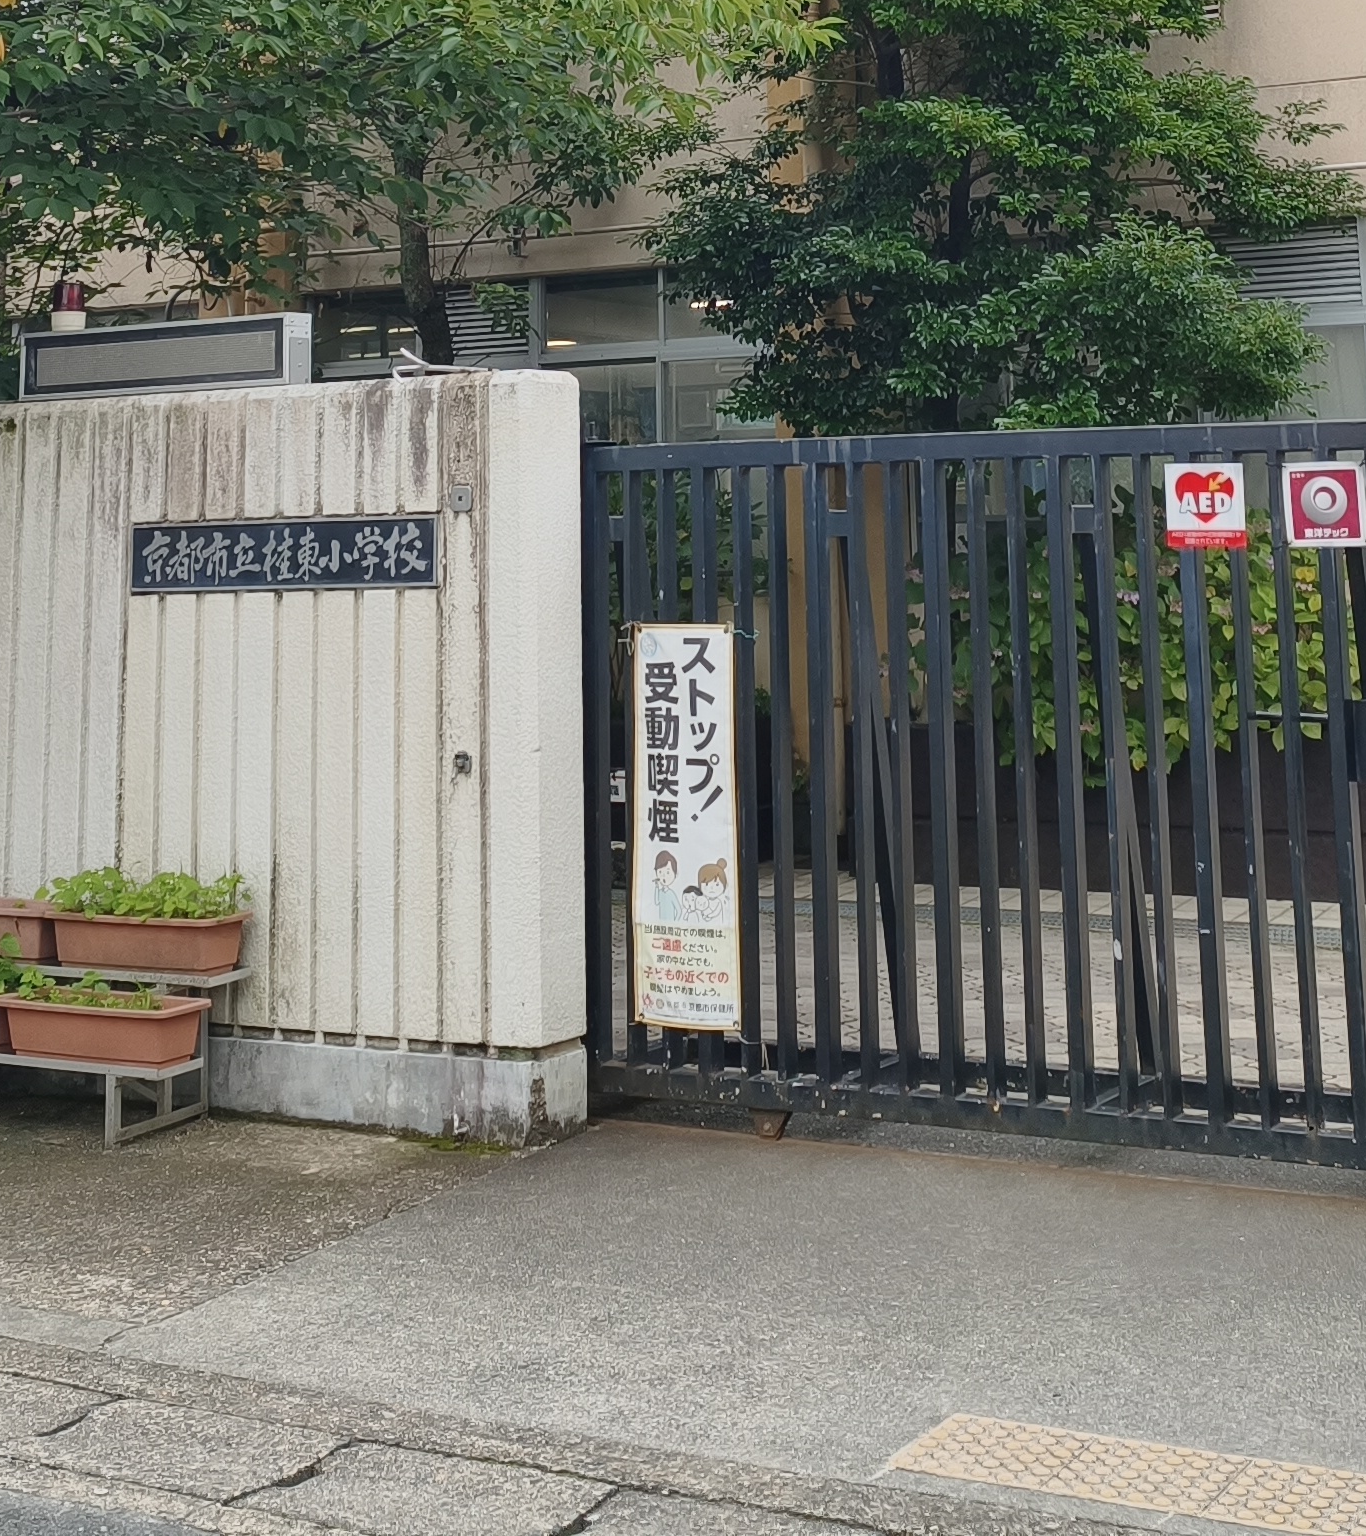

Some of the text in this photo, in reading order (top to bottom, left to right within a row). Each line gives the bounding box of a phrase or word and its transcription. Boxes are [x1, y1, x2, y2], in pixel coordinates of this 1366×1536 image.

[1179, 492, 1232, 514] AED
[1304, 527, 1349, 538] 東洋テック
[142, 522, 428, 585] 京都市立桂東小学校
[645, 662, 680, 843] 受動喫煙
[644, 966, 729, 983] 子どもの近くでの
